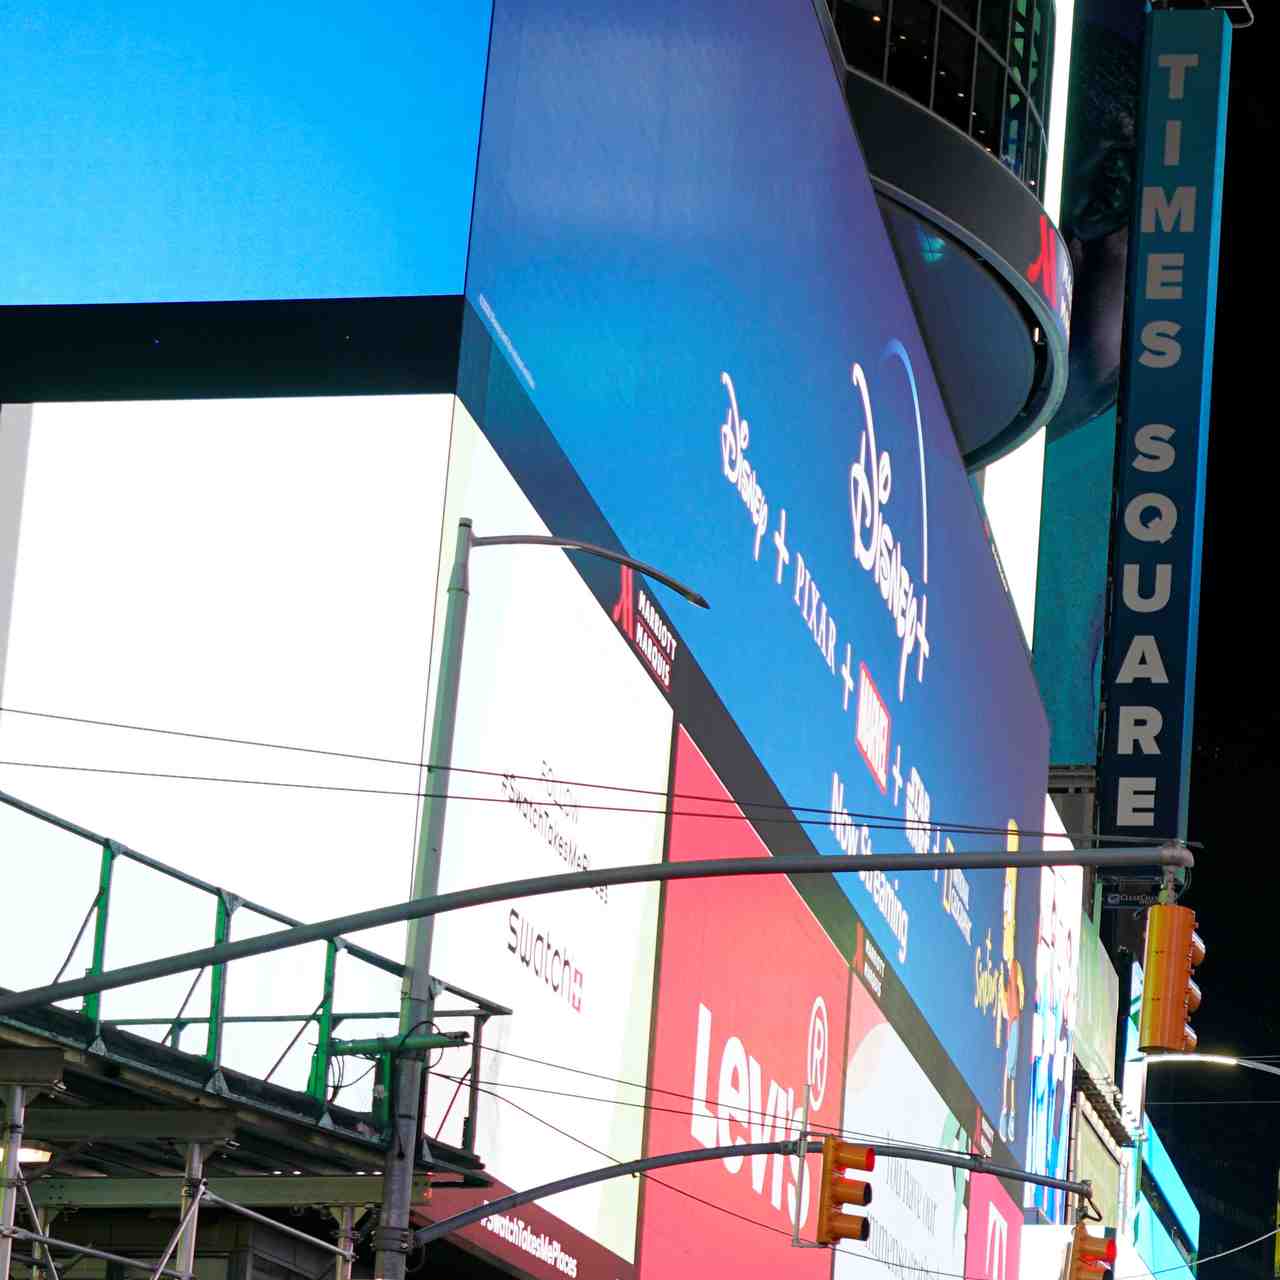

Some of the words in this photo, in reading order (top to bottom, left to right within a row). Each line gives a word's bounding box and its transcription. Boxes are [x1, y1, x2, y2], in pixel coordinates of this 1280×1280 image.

[1138, 54, 1200, 370] TIMES
[635, 621, 671, 687] MARQUIS
[638, 589, 678, 662] MARRIOTT
[1115, 422, 1178, 828] SQUARE
[507, 906, 572, 1003] swatch
[689, 1002, 813, 1231] Levi's
